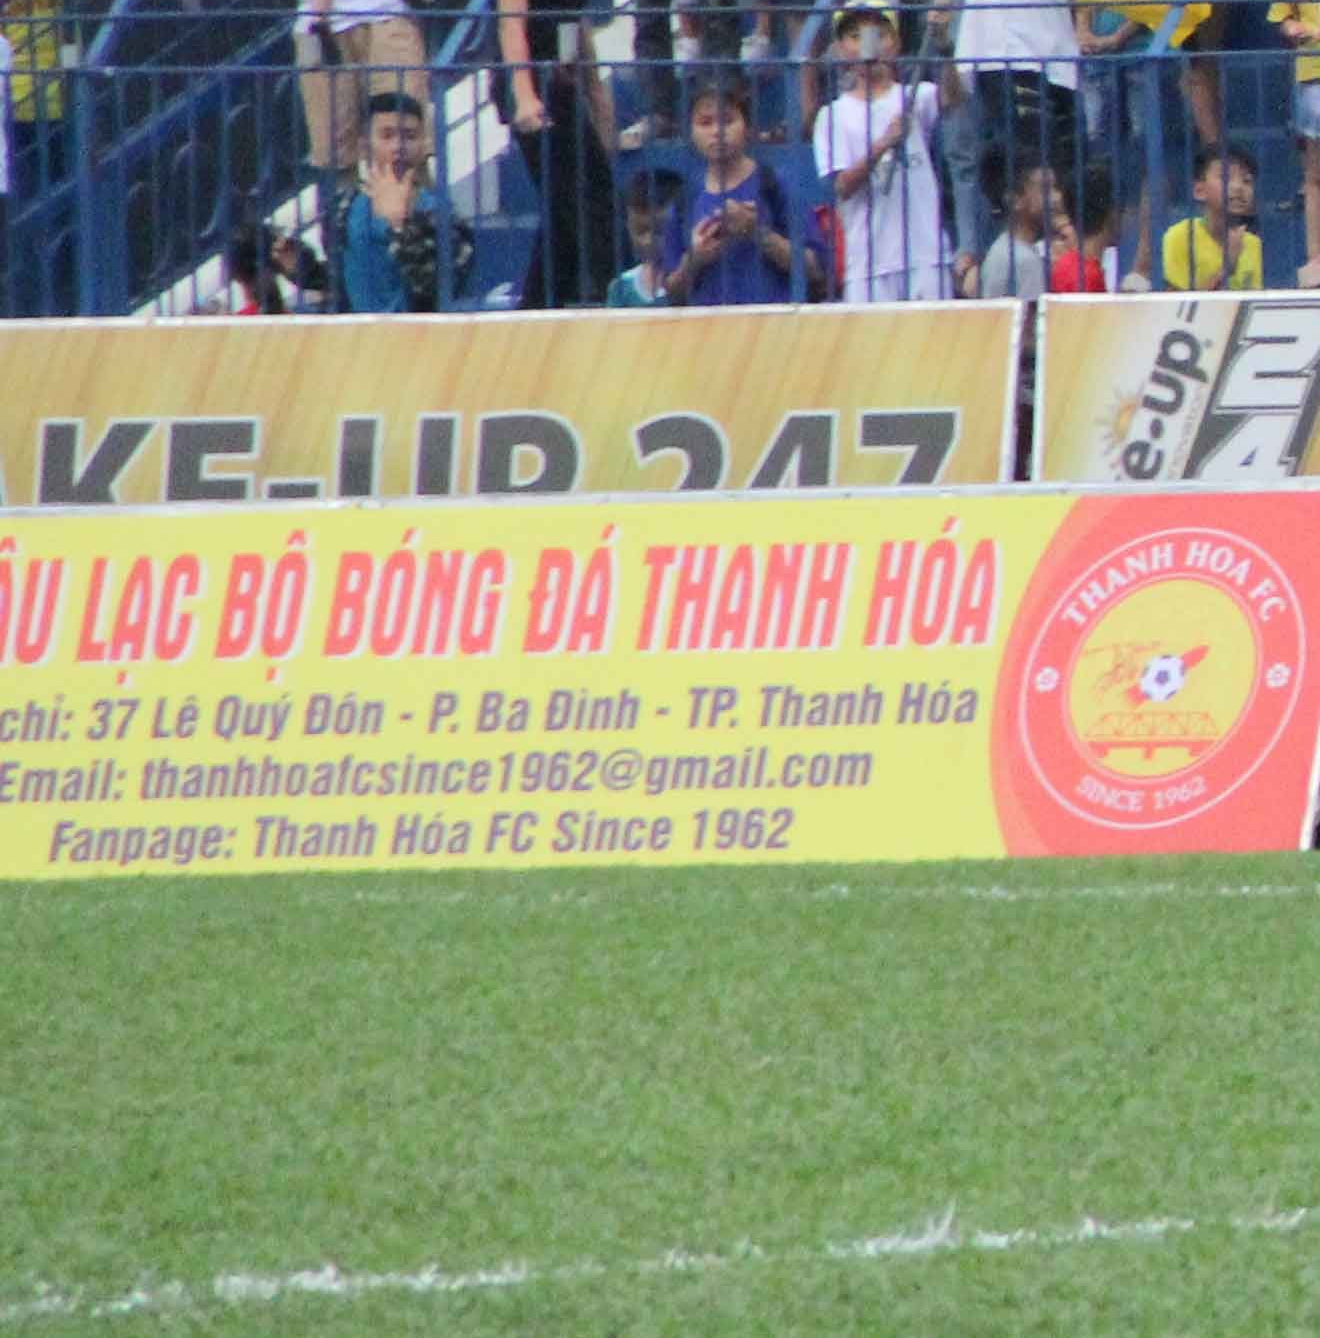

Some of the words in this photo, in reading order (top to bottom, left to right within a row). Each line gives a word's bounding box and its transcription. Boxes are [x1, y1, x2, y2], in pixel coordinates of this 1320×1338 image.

[75, 551, 200, 686] LẠC
[213, 528, 309, 682] BỘ
[322, 528, 505, 657] BÓNG
[522, 523, 615, 652] ĐÁ
[637, 542, 850, 652] THANH
[863, 517, 998, 647] HÓA
[1061, 542, 1174, 629] THANH
[1185, 539, 1250, 584] HOA
[1247, 571, 1288, 623] FC
[86, 697, 141, 740] 37
[151, 695, 200, 739] Lê
[213, 692, 292, 742] Quý
[428, 690, 460, 735] P.
[475, 689, 531, 733] Ba
[688, 687, 739, 730] TP.
[759, 683, 884, 729] Thanh
[898, 678, 980, 727] Hóa
[140, 746, 873, 802] thanhhoafcsince1962@gmail.com
[1074, 774, 1145, 813] SINCE
[1152, 774, 1207, 811] 1962
[49, 818, 237, 866] Fanpage:
[253, 813, 379, 859] Thanh
[391, 808, 472, 857] Hóa
[484, 812, 538, 855] FC
[551, 808, 673, 855] Since
[691, 807, 796, 852] 1962
